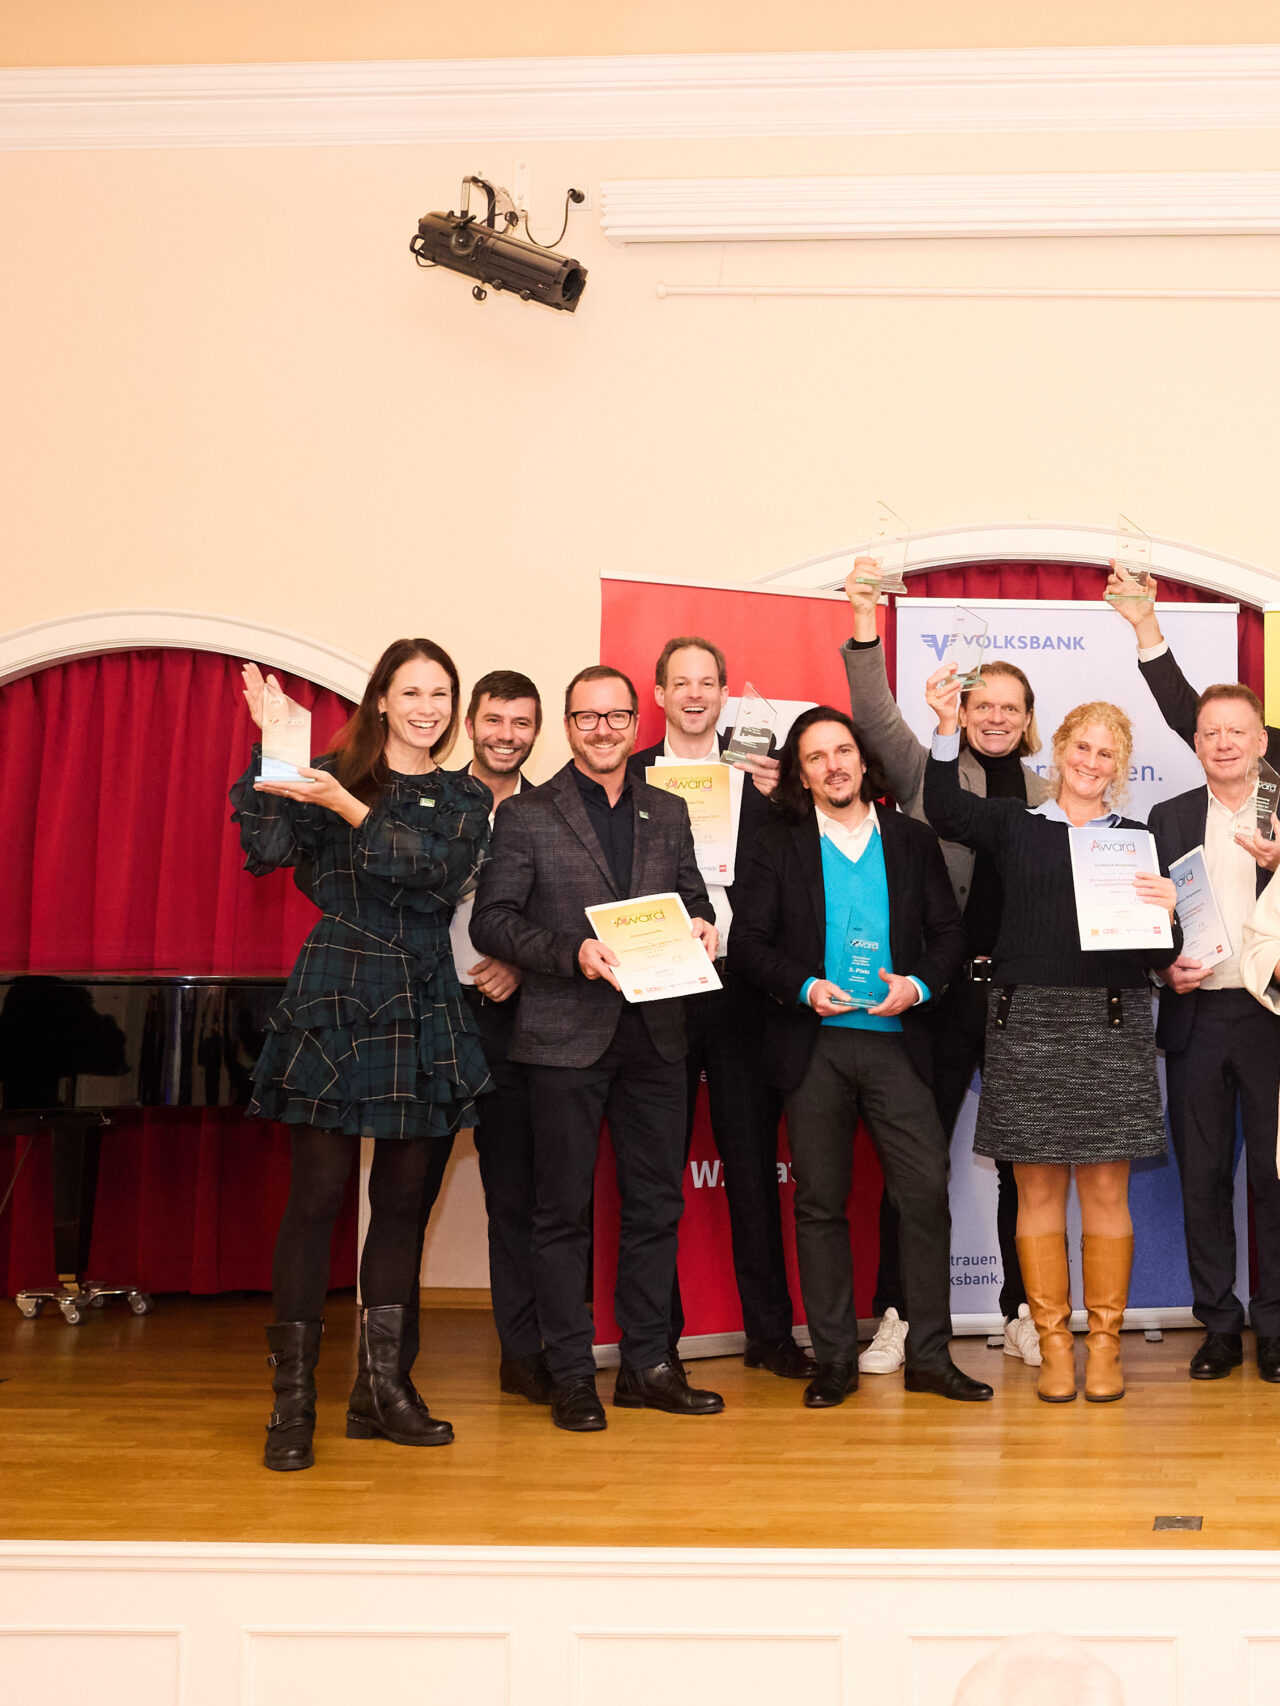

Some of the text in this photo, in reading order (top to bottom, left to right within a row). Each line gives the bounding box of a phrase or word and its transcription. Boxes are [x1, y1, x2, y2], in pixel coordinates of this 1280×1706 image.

[963, 634, 1085, 650] VOLKSBANK
[1091, 840, 1136, 852] Award
[614, 909, 665, 928] Award
[950, 1255, 997, 1266] trauen
[950, 1272, 1002, 1285] ksbank.
